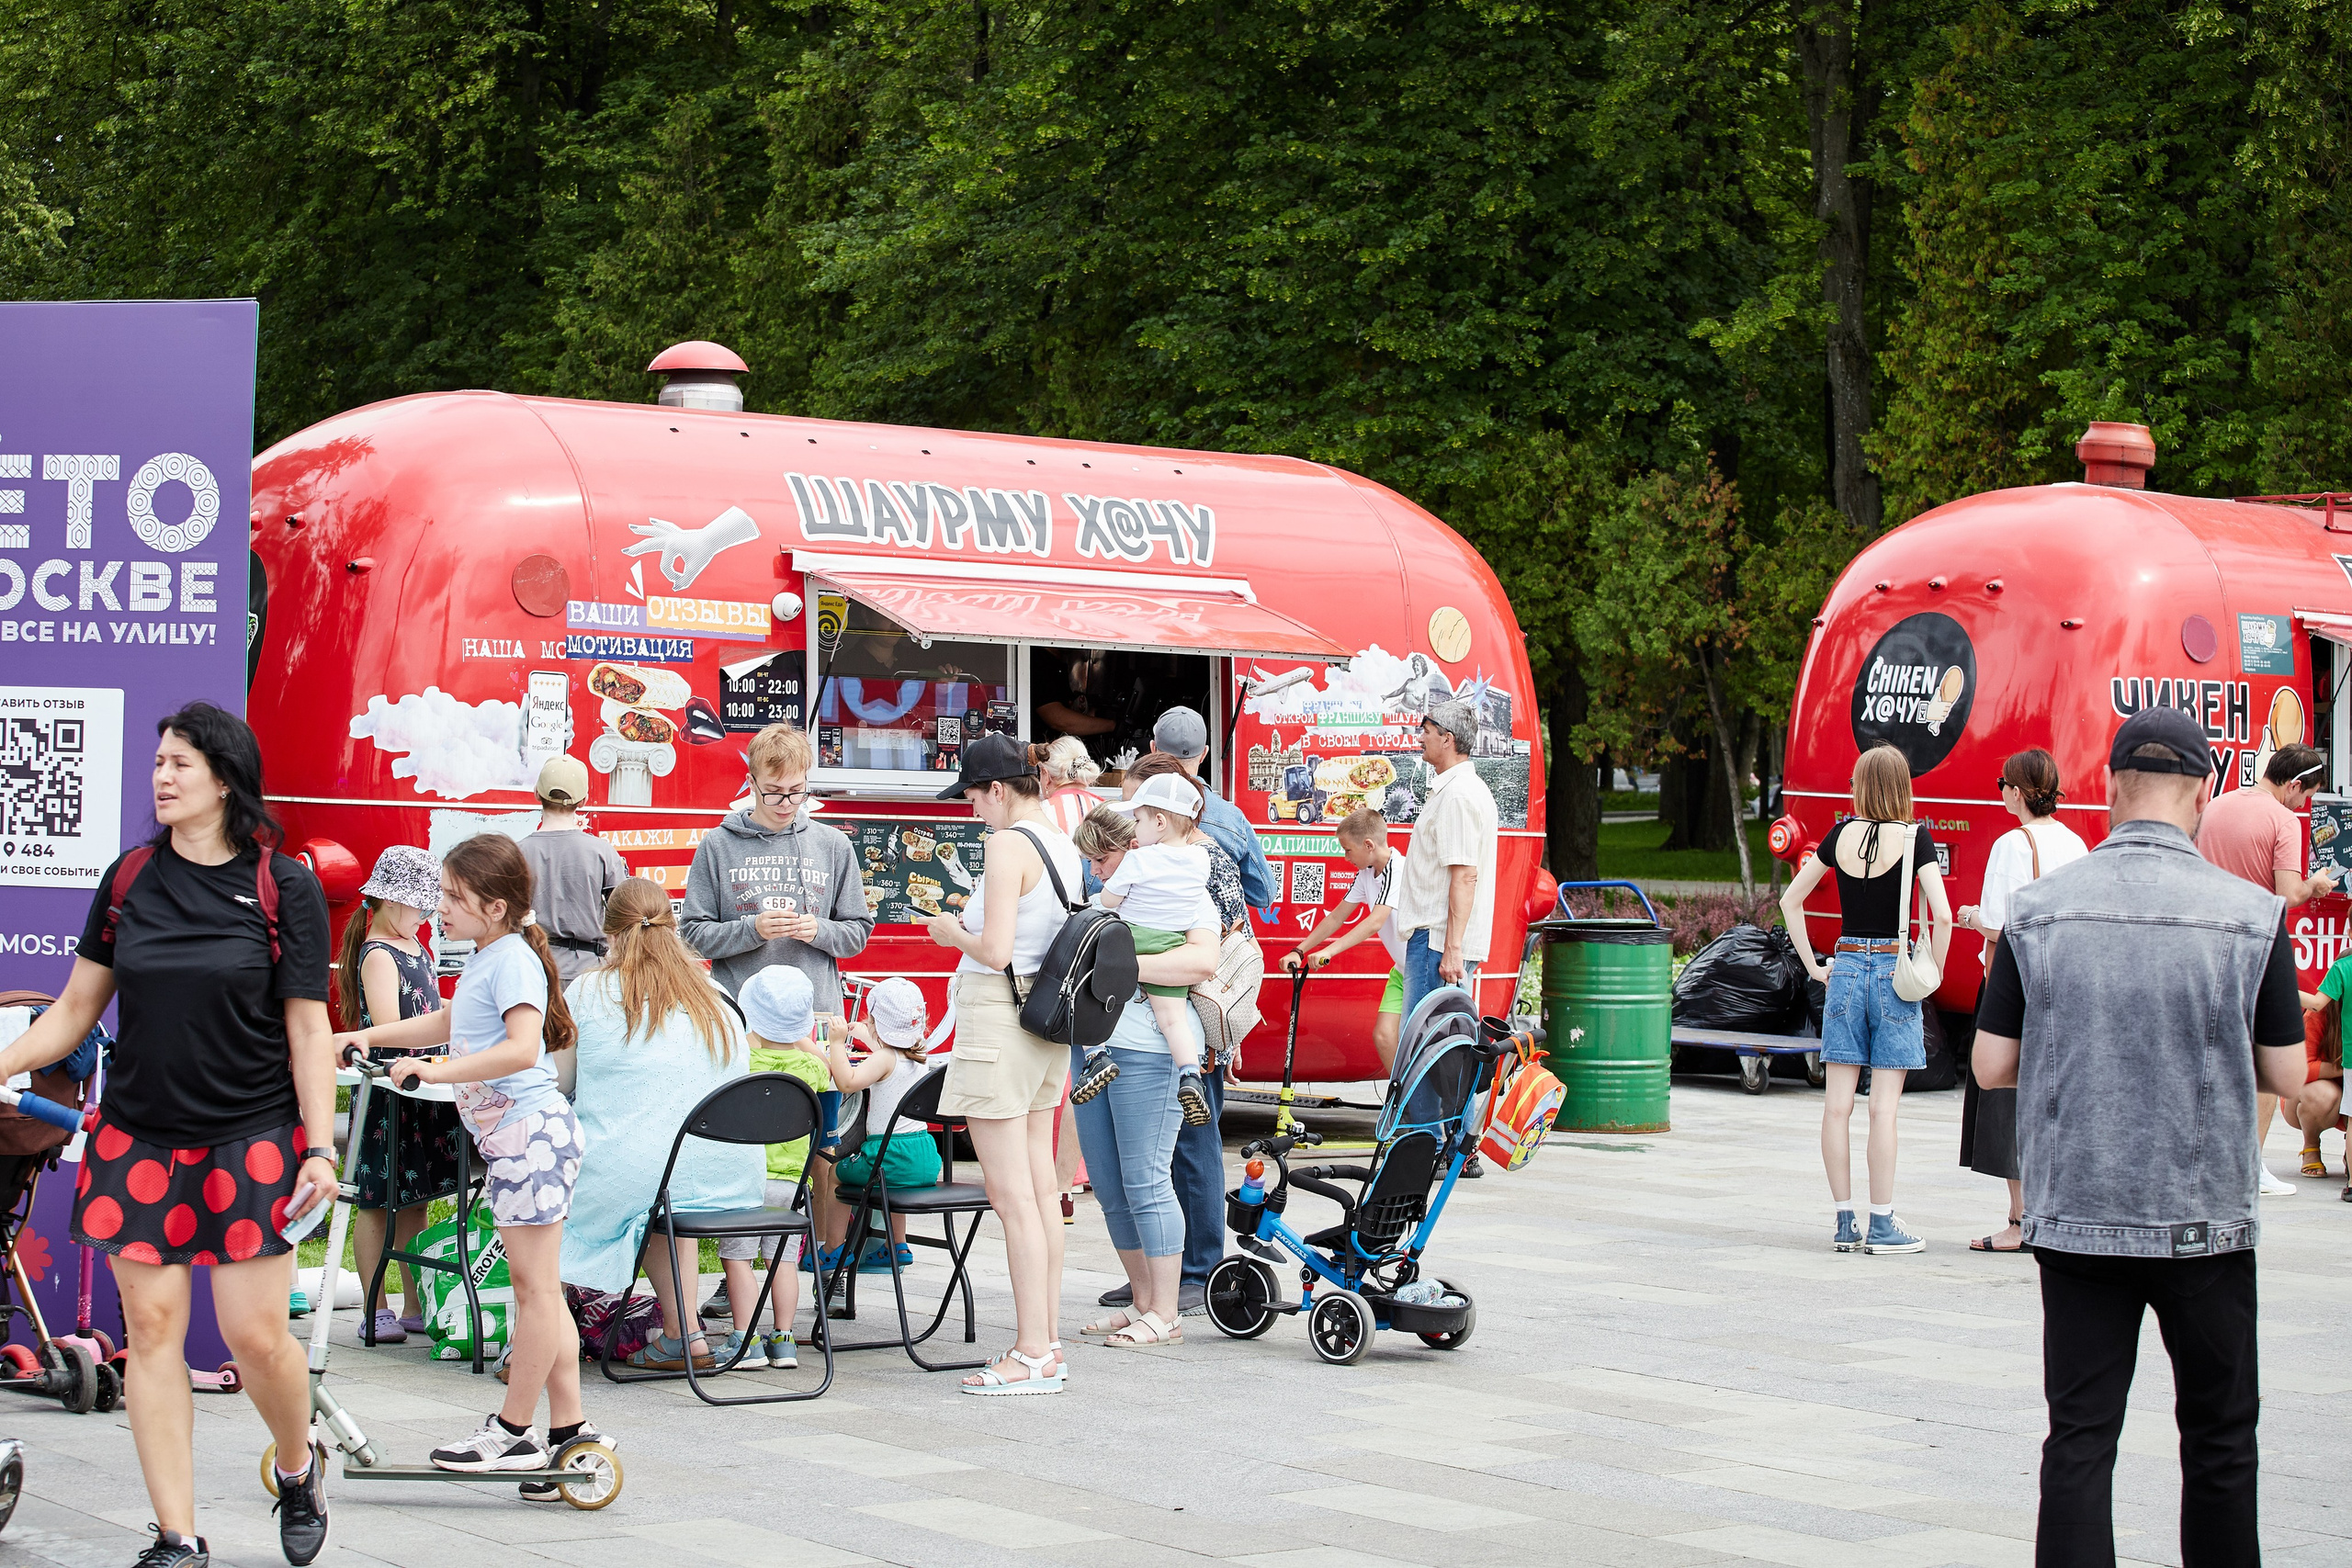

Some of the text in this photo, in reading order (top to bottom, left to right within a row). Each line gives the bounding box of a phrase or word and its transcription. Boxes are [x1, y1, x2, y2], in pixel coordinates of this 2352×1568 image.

[785, 472, 1053, 558] ШАУРМУ
[568, 596, 770, 628] ВАШИ ОТЗЫВЫ
[1, 621, 217, 645] ВСЕ НА УЛИЦУ!
[463, 638, 526, 660] НАША
[567, 635, 693, 662] МОТИВАЦИЯ
[1867, 658, 1939, 694] CHIKEN
[727, 678, 755, 694] 10:00
[768, 680, 798, 694] 22:00
[0, 698, 85, 709] АВИТЬ ОТЗЫВ
[532, 695, 565, 711] Яндекс
[726, 703, 754, 717] 10:00
[768, 705, 798, 719] 23:00
[531, 716, 562, 732] Google
[1317, 711, 1383, 725] ФРАНШИЗУ
[1302, 735, 1311, 748] В
[1318, 735, 1361, 748] СВОЕМ
[21, 843, 55, 858] 484
[745, 856, 815, 867] PROPERTY OF
[11, 865, 41, 875] СВОЕ
[44, 866, 100, 876] СОБЫТИЕ
[729, 867, 781, 883] TOKYO
[763, 883, 796, 893] WATER
[736, 902, 759, 912] WORK
[772, 898, 786, 908] 68
[472, 1249, 496, 1287] EROY
